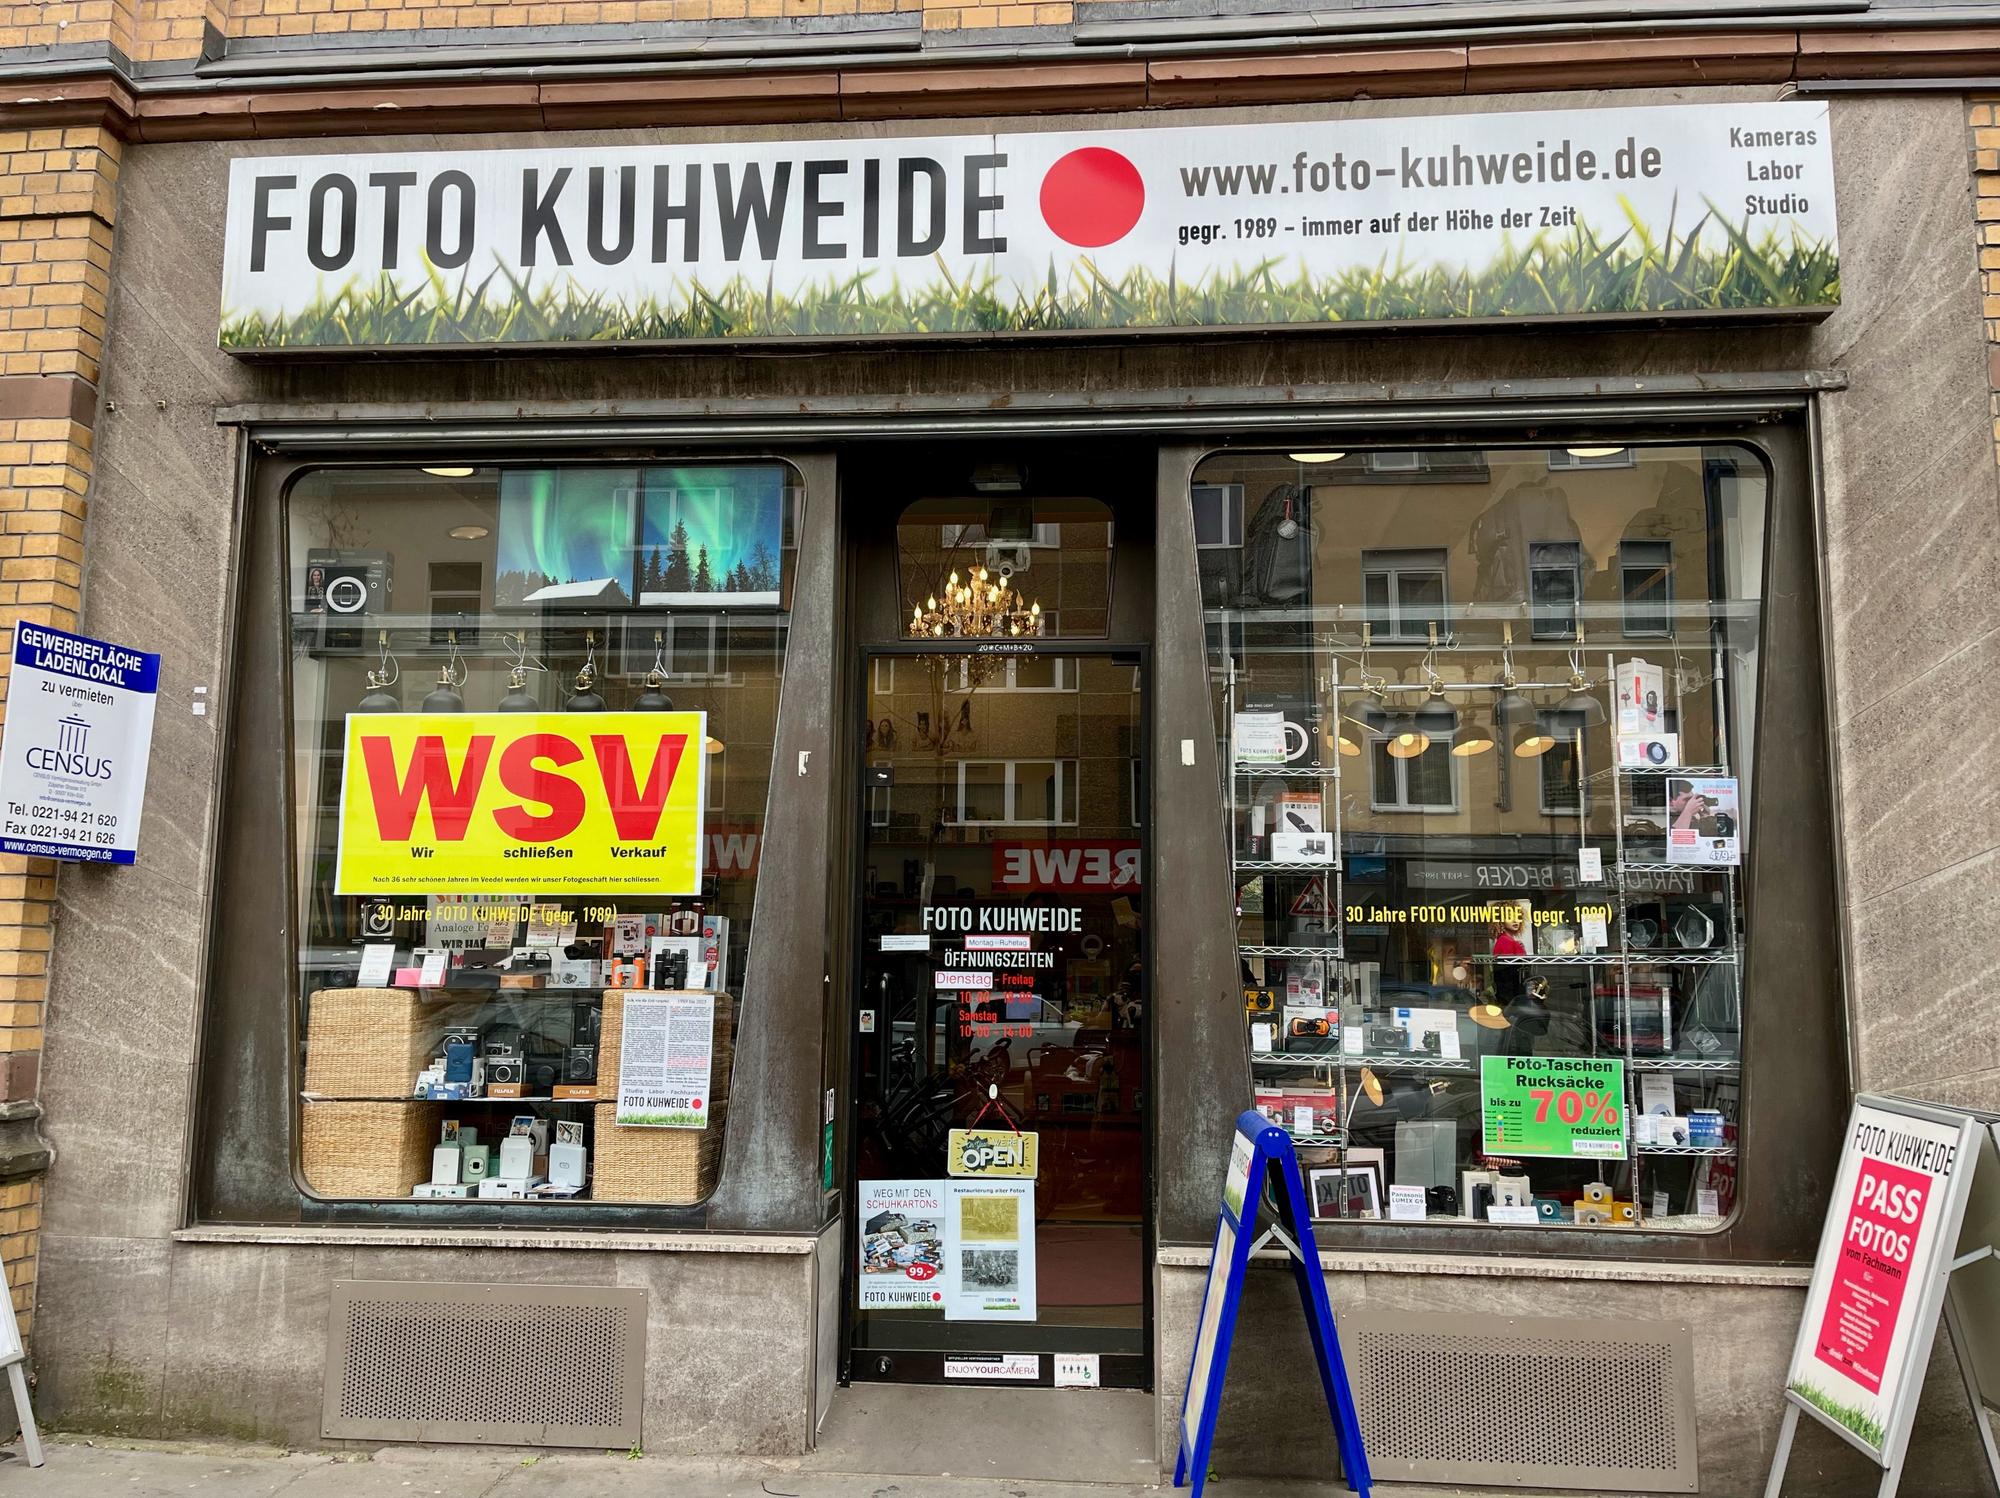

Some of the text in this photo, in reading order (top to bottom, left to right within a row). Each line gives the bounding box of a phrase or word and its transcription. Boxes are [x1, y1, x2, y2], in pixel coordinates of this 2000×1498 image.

[1730, 125, 1818, 149] Kameras
[1179, 137, 1663, 198] www.foto-kuhweide.de
[1747, 161, 1804, 183] Labor
[250, 152, 1008, 272] FOTO KUHWEIDE
[1745, 194, 1809, 216] Studio
[1178, 221, 1227, 246] gegr.
[1233, 217, 1277, 239] 1989
[1301, 213, 1362, 236] immer
[1368, 211, 1401, 234] auf
[1407, 210, 1440, 233] der
[1446, 207, 1493, 231] Höhe
[1501, 208, 1533, 229] der
[1539, 205, 1577, 227] Zeit
[21, 628, 143, 673] GEWERBEFLÄCHE
[35, 649, 126, 686] LADENLOKAL
[41, 680, 115, 706] zu vermieten
[26, 747, 113, 780] CENSUS
[360, 733, 689, 843] WSV
[7, 801, 118, 827] Tel. 0221-94 21 620
[5, 820, 116, 845] Fax 0221-94 21 626
[3, 839, 113, 861] www.census-vermoegen.de
[411, 846, 667, 859] Wir schließen Verkauf
[373, 875, 391, 883] Nach
[391, 875, 401, 883] 36
[402, 875, 417, 883] sehr
[418, 875, 446, 883] schönen
[447, 875, 470, 883] Jahren
[481, 875, 504, 883] Veedel
[505, 875, 529, 883] werden
[530, 875, 541, 883] wir
[543, 875, 562, 883] unser
[563, 875, 608, 884] Fotogeschäft
[609, 875, 623, 883] hier
[377, 905, 393, 921] 30
[396, 905, 432, 921] Jahre
[435, 905, 468, 922] FOTO
[471, 905, 537, 923] KUHWEIDE
[541, 903, 578, 926] (gegr.
[582, 903, 618, 924] 1989)
[922, 906, 1082, 931] FOTO KUHWEIDE
[1345, 905, 1364, 923] 30
[1367, 905, 1407, 923] Jahre
[1410, 905, 1447, 923] FOTO
[1450, 905, 1523, 924] KUHWEIDE
[1528, 902, 1569, 927] (gegr.
[434, 922, 474, 934] Analoge
[440, 939, 464, 949] WIR
[968, 939, 994, 947] Montag
[1000, 939, 1027, 947] Ruhetag
[944, 948, 1054, 968] ÖFFNUNGSZEITEN
[936, 972, 992, 987] Dienstag
[1002, 973, 1034, 987] Freitag
[959, 1010, 998, 1023] Samstag
[959, 1025, 991, 1038] 10:00
[1002, 1025, 1033, 1038] 14:00
[1507, 1057, 1613, 1073] Foto-Taschen
[1516, 1074, 1605, 1089] Rucksäcke
[623, 1096, 690, 1109] FOTO KUHWEIDE
[1490, 1097, 1522, 1107] bis zu
[1529, 1090, 1618, 1125] 70%
[1571, 1126, 1621, 1136] reduziert
[962, 1136, 1024, 1168] OPEN
[1852, 1122, 1957, 1177] FOTO KUHWEIDE
[866, 1199, 938, 1209] SCHUHKARTONS
[873, 1188, 931, 1198] WEG MIT DEN
[1856, 1173, 1923, 1225] PASS
[1848, 1215, 1911, 1264] FOTOS
[908, 1266, 933, 1278] 99,-
[1845, 1247, 1861, 1261] vom
[1861, 1252, 1903, 1280] Fachmann
[864, 1291, 931, 1303] FOTO KUHWEIDE
[946, 1365, 1036, 1376] ENJOYYOURCAMERA
